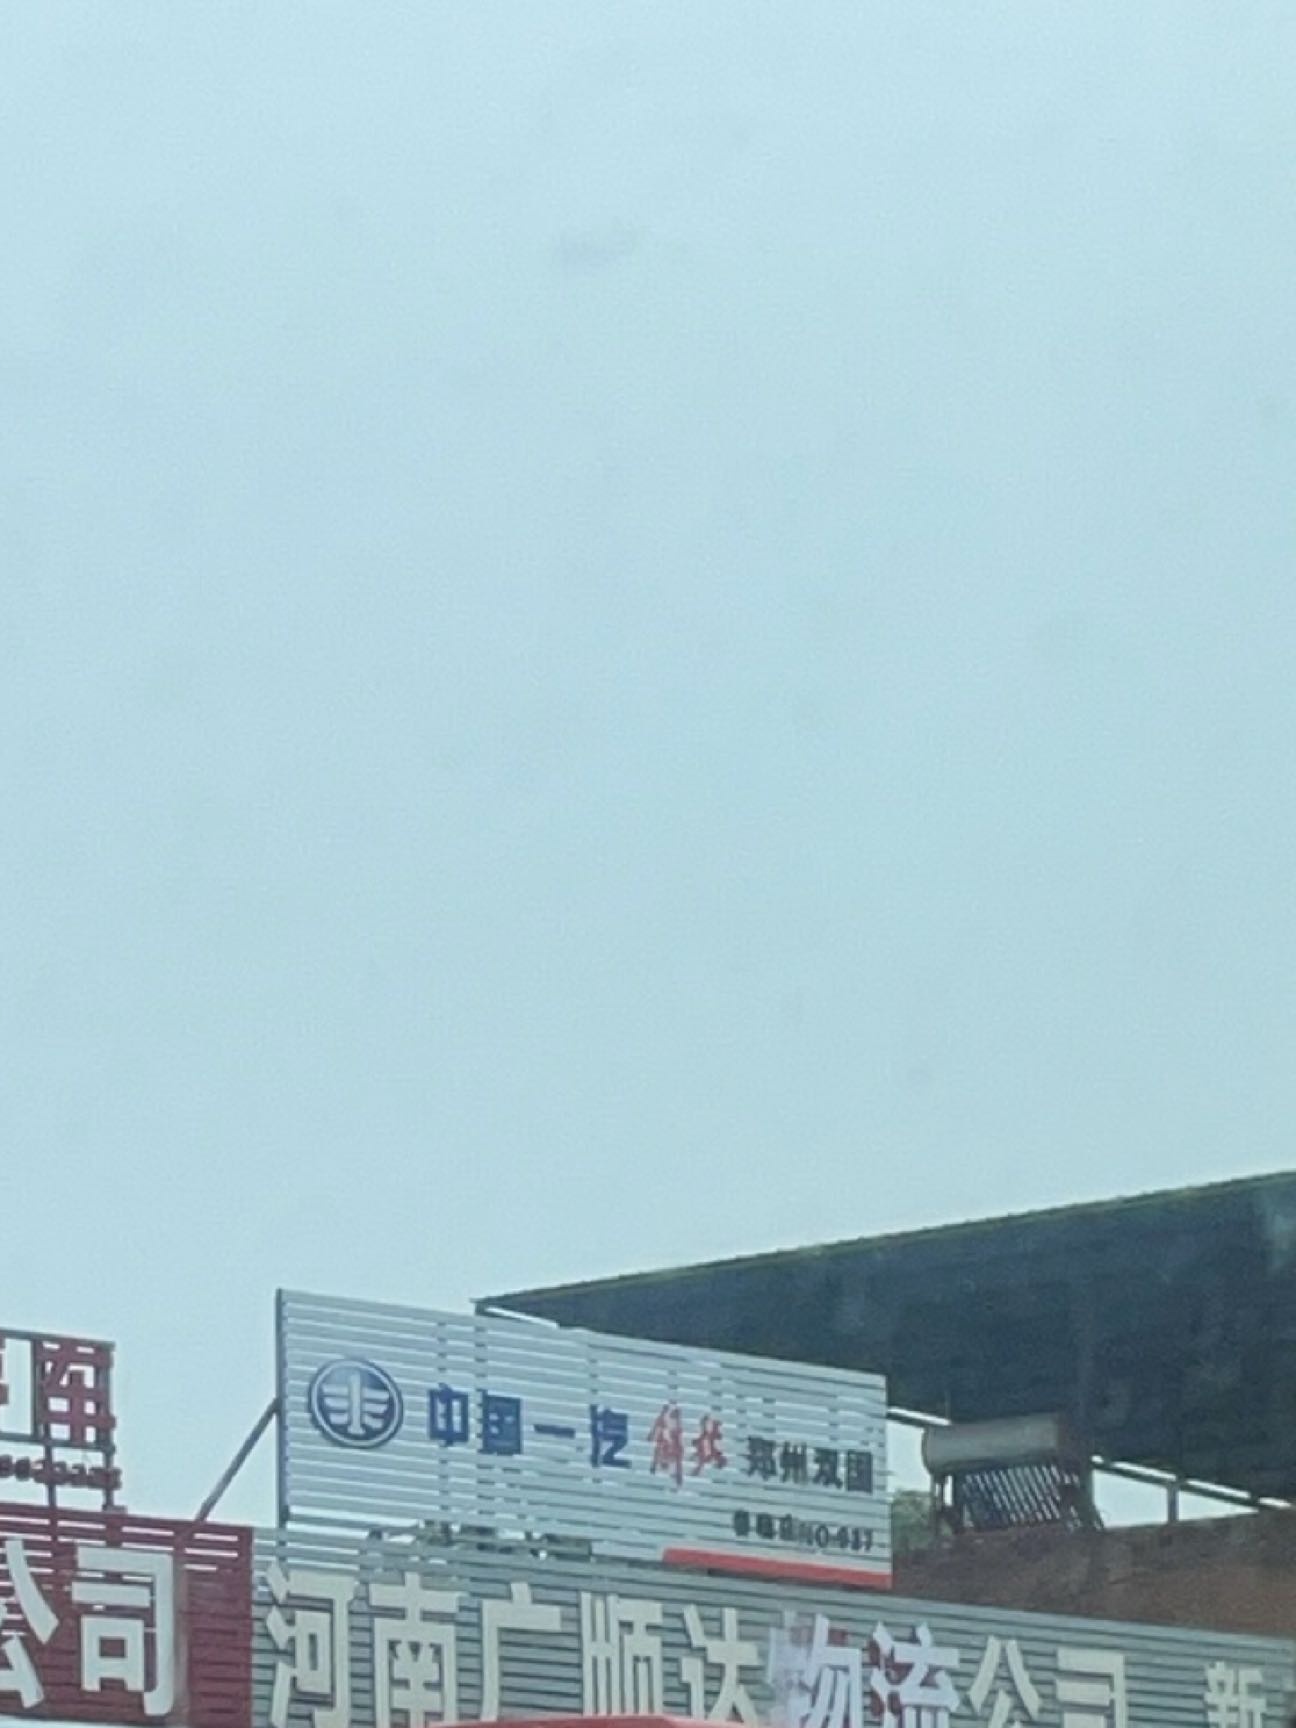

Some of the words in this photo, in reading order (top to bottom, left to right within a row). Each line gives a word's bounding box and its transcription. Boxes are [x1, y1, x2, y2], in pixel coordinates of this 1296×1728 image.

[428, 1384, 631, 1468] 中国一汽
[648, 1401, 727, 1489] 解放
